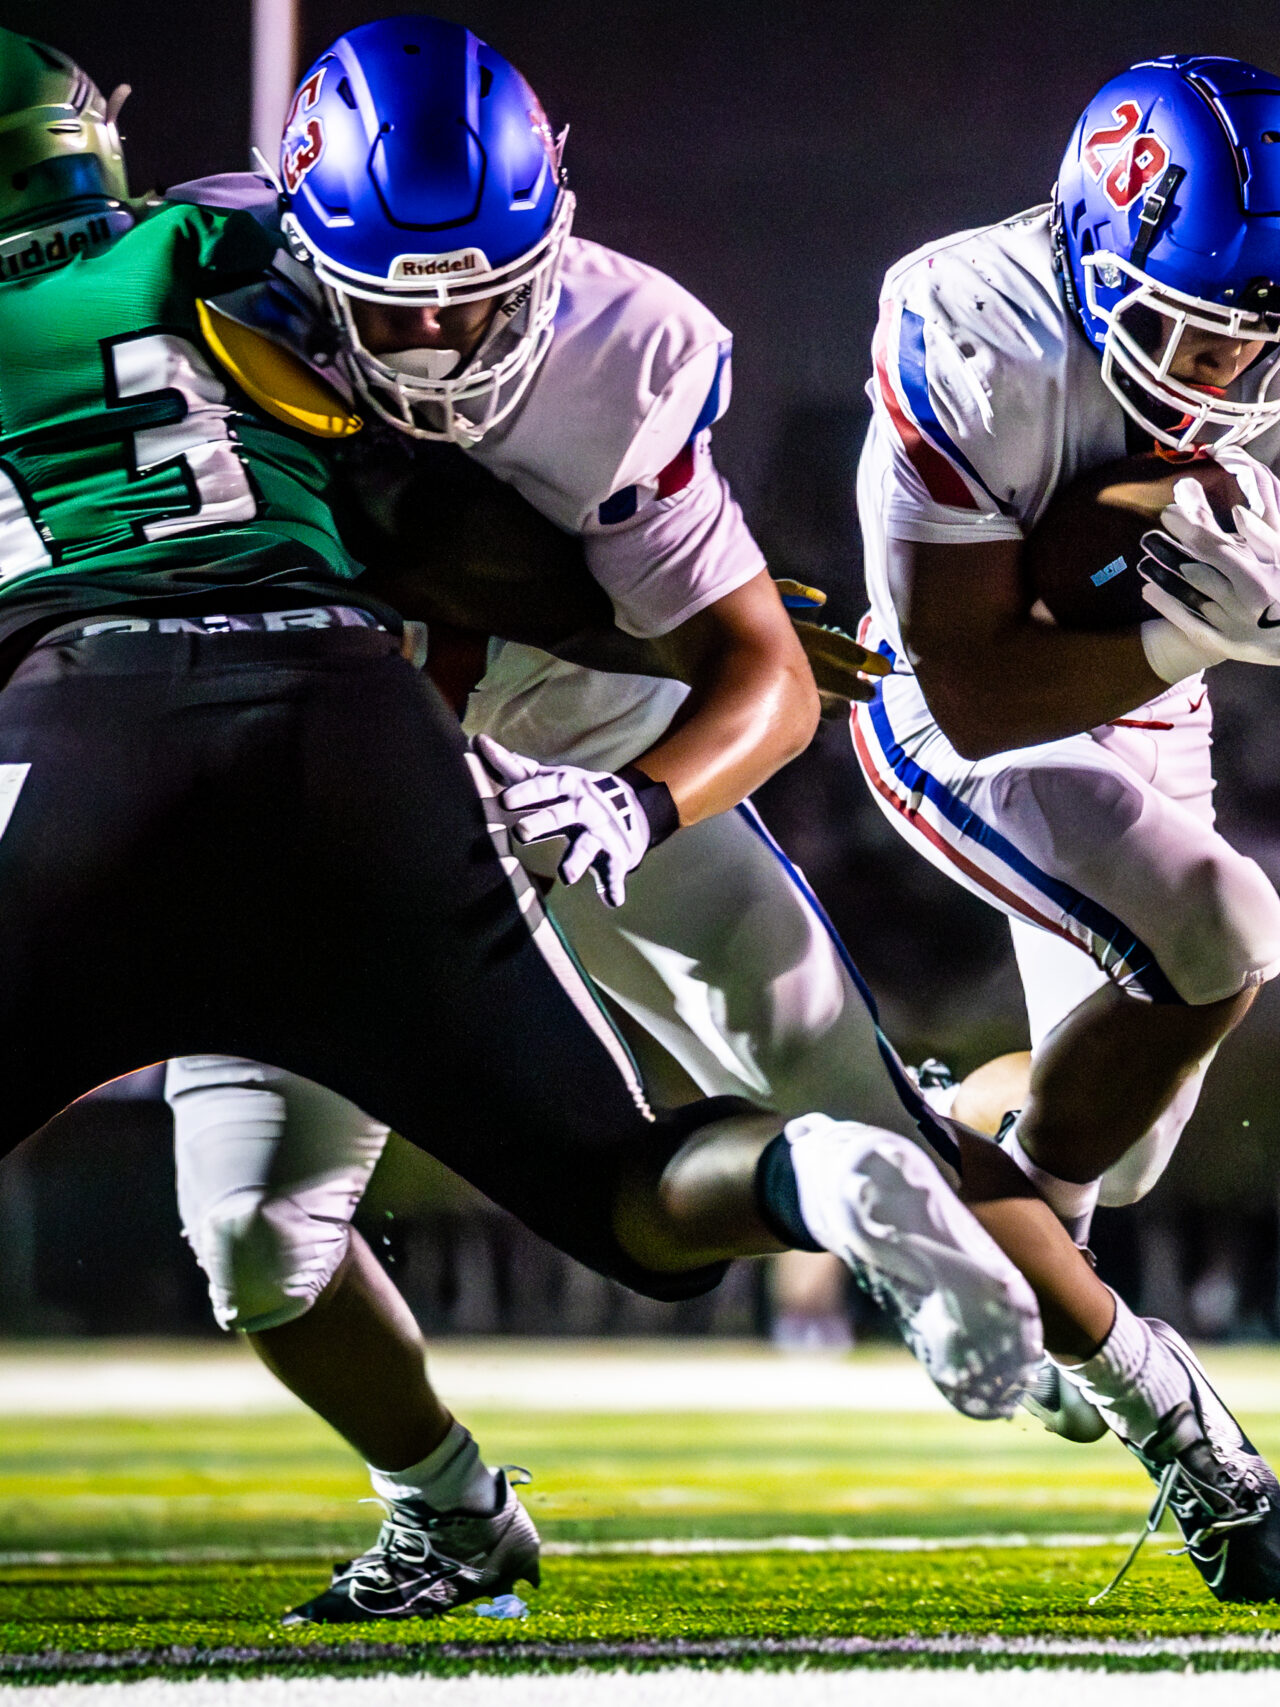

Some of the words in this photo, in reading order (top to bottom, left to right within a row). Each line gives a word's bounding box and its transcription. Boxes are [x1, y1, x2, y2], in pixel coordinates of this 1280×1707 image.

[1084, 100, 1171, 212] 28
[0, 217, 112, 281] iddell
[402, 254, 476, 276] Riddell
